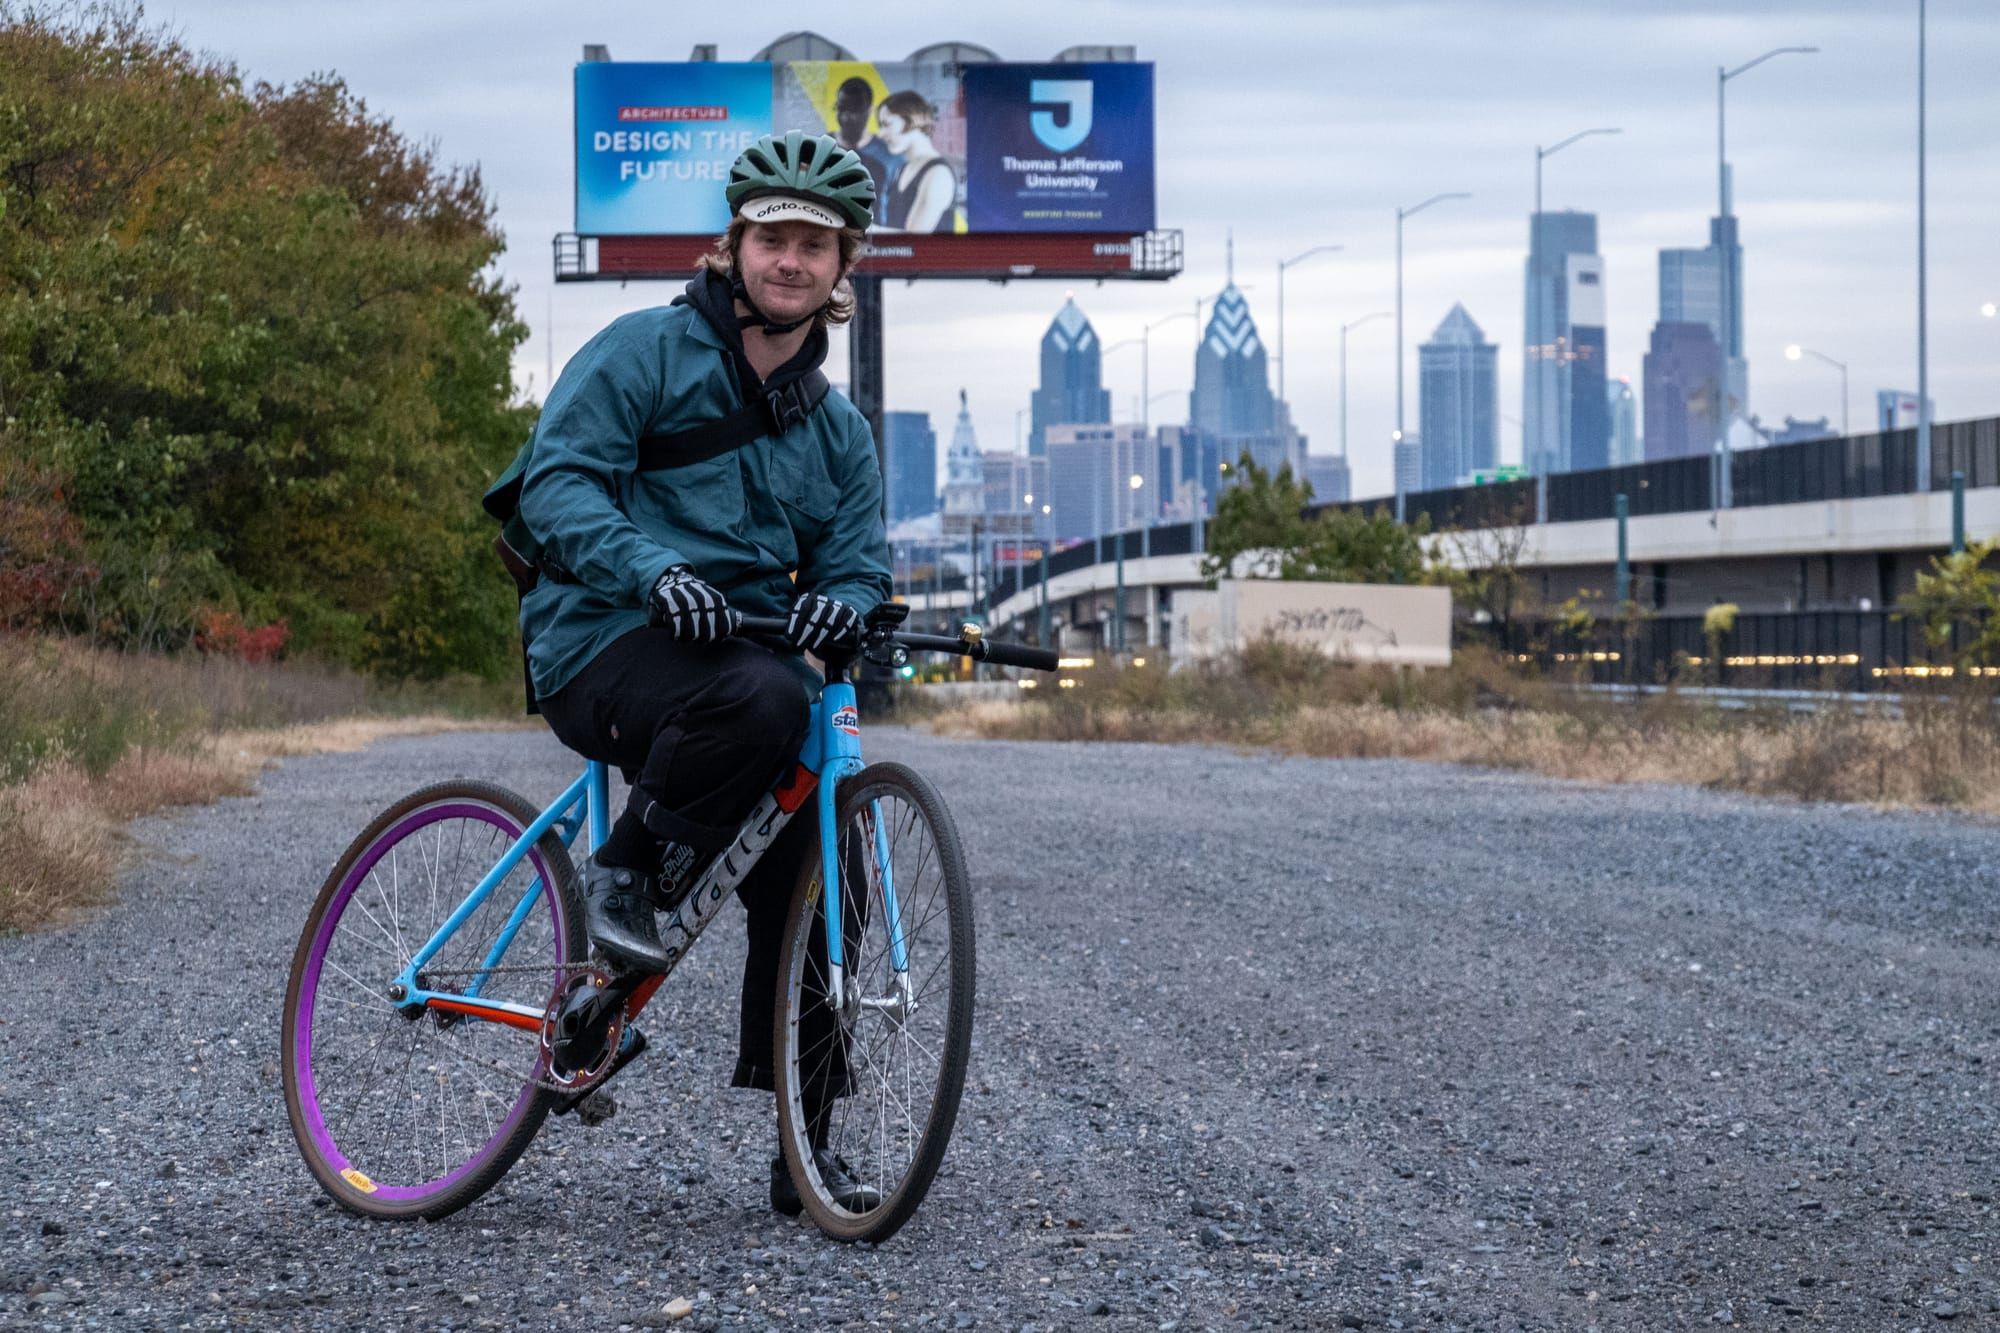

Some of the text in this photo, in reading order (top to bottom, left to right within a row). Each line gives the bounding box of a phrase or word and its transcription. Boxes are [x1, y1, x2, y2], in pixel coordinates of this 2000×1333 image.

[622, 107, 724, 119] ARCHITECTURE
[593, 131, 753, 152] DESIGN THE
[620, 160, 727, 182] FUTURE
[1003, 156, 1123, 172] Thomas Jefferson
[1025, 173, 1098, 192] University
[757, 201, 833, 225] ofoto.com
[658, 844, 696, 878] Philly
